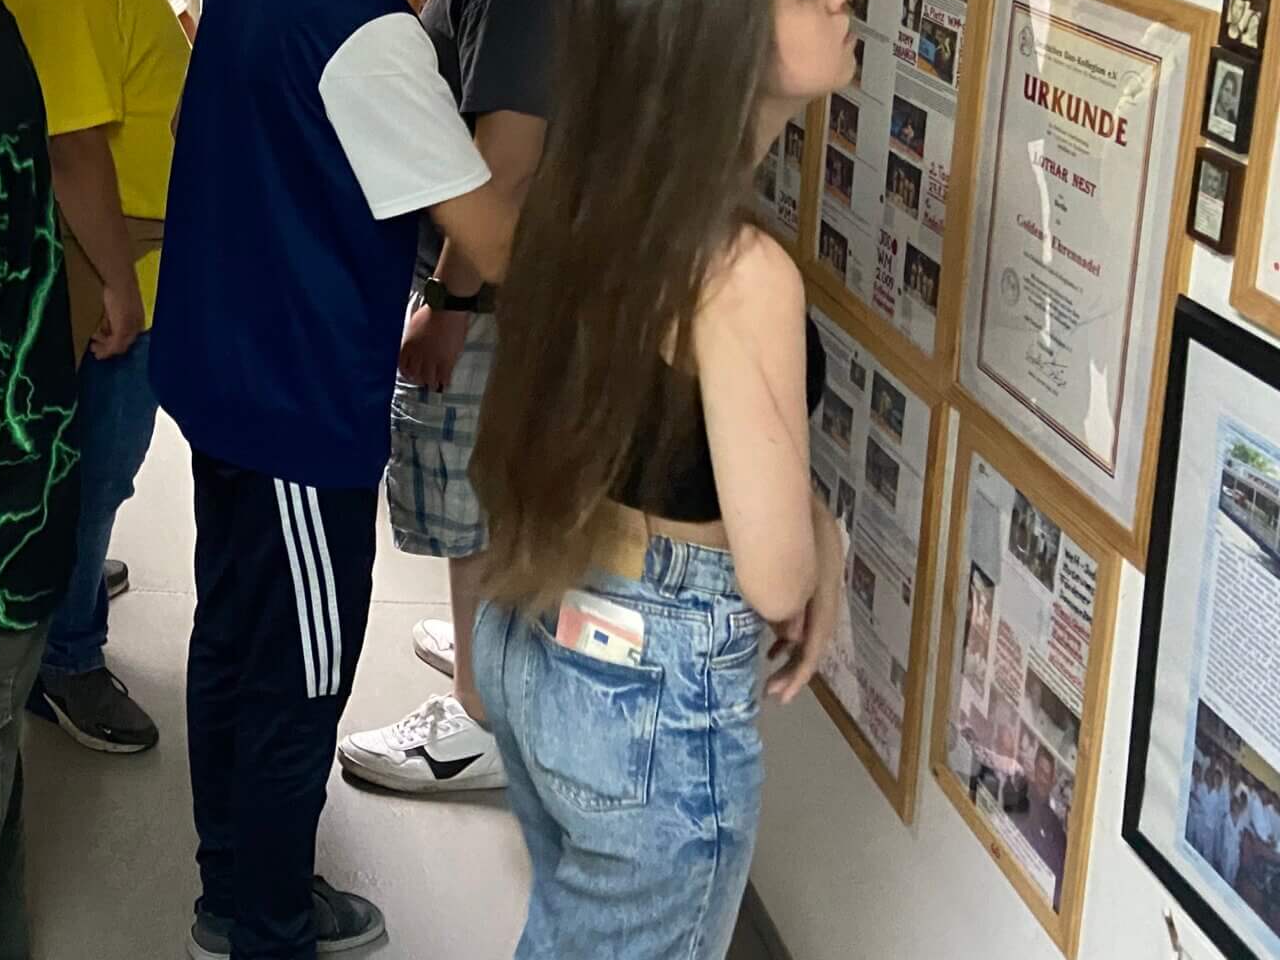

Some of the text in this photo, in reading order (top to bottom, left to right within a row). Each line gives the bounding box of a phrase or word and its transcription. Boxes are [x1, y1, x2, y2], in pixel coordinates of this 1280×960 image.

[1023, 73, 1128, 147] URKUNDE
[1072, 173, 1097, 197] NEST
[1016, 213, 1049, 241] Golden
